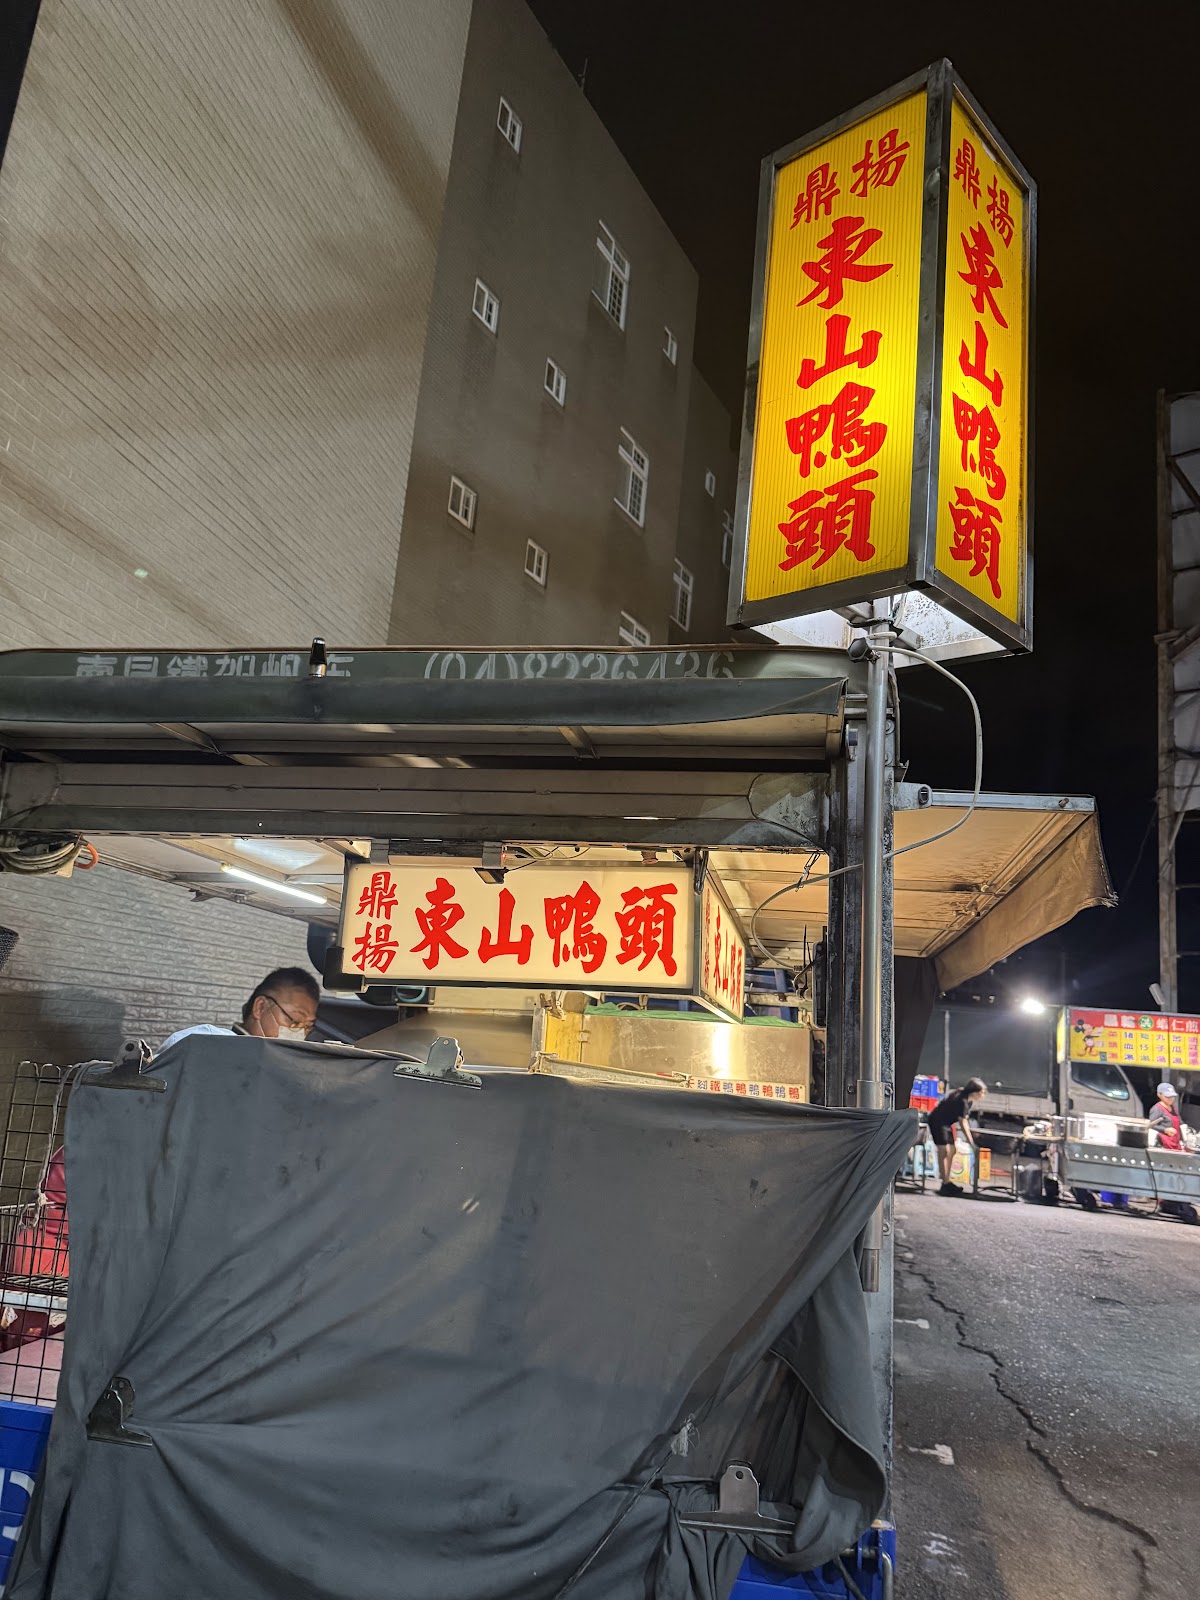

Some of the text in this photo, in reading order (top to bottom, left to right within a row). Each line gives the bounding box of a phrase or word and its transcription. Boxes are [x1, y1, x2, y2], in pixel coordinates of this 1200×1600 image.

[789, 128, 910, 230] 鼎揚
[953, 138, 1015, 249] 鼎揚
[777, 215, 893, 571] 東山鴨頭
[948, 221, 1008, 599] 東山鴨頭
[351, 871, 399, 973] 鼎揚
[409, 877, 679, 977] 東山鴨頭
